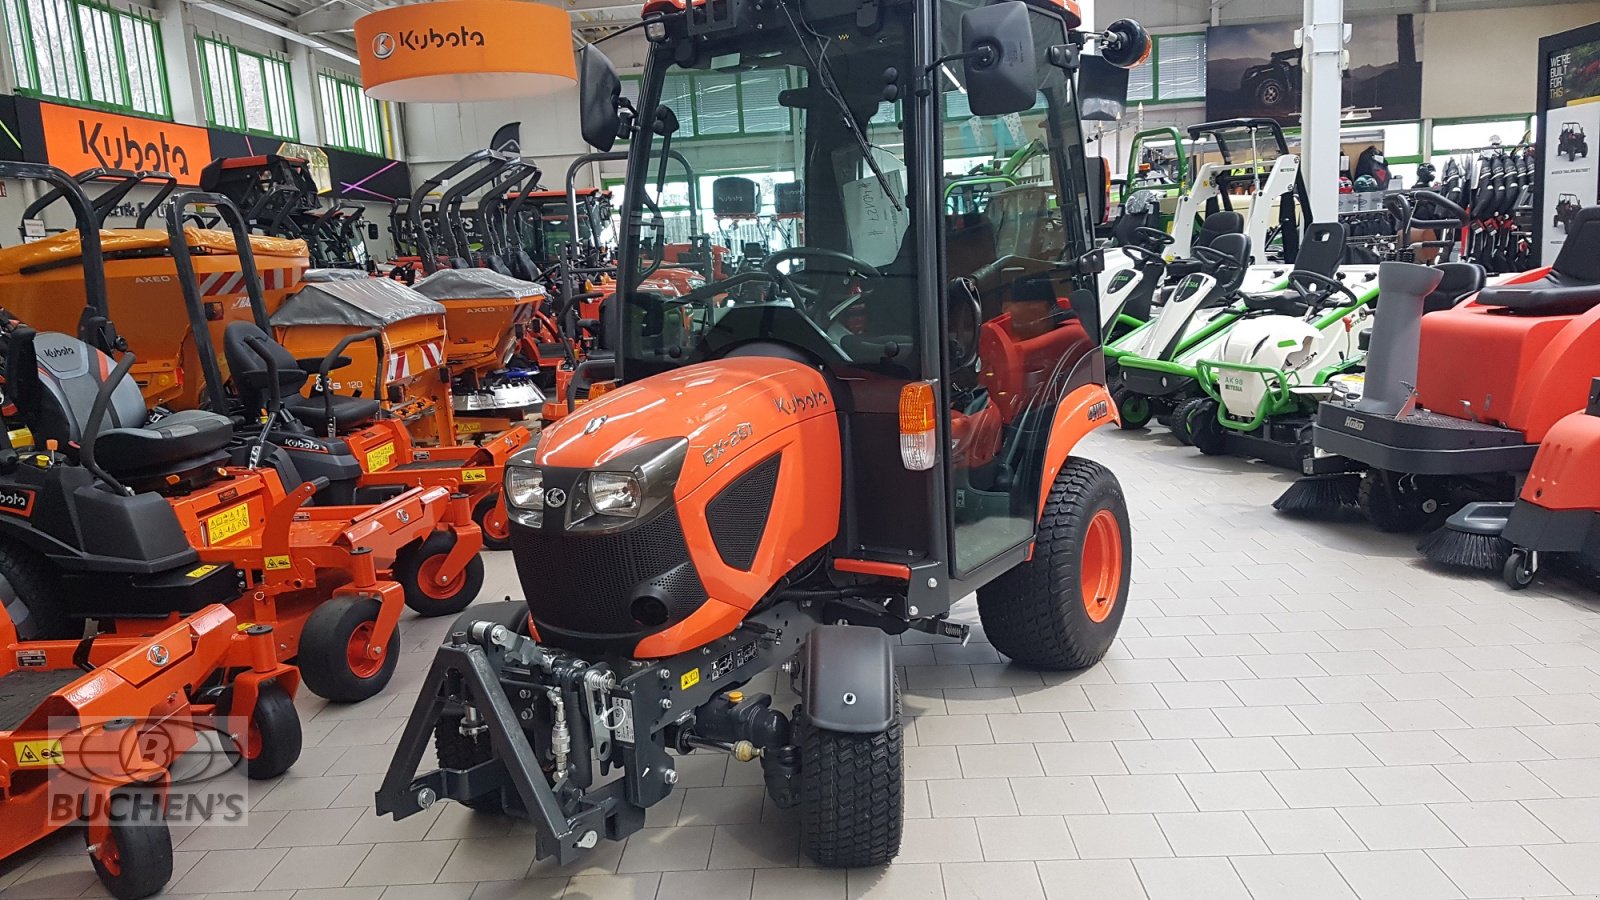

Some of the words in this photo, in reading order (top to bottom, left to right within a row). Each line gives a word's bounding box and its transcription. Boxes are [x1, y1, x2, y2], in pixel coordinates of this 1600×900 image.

[399, 26, 485, 50] Kubota
[1550, 65, 1568, 78] BUILT
[1550, 76, 1563, 88] FOR
[1550, 87, 1564, 99] THIS
[79, 120, 189, 176] Kubota
[135, 275, 171, 283] AXEO
[44, 346, 75, 358] Kubota
[347, 380, 363, 389] 120
[773, 389, 828, 416] Kubota
[284, 438, 320, 450] Kubota
[0, 491, 26, 506] bota
